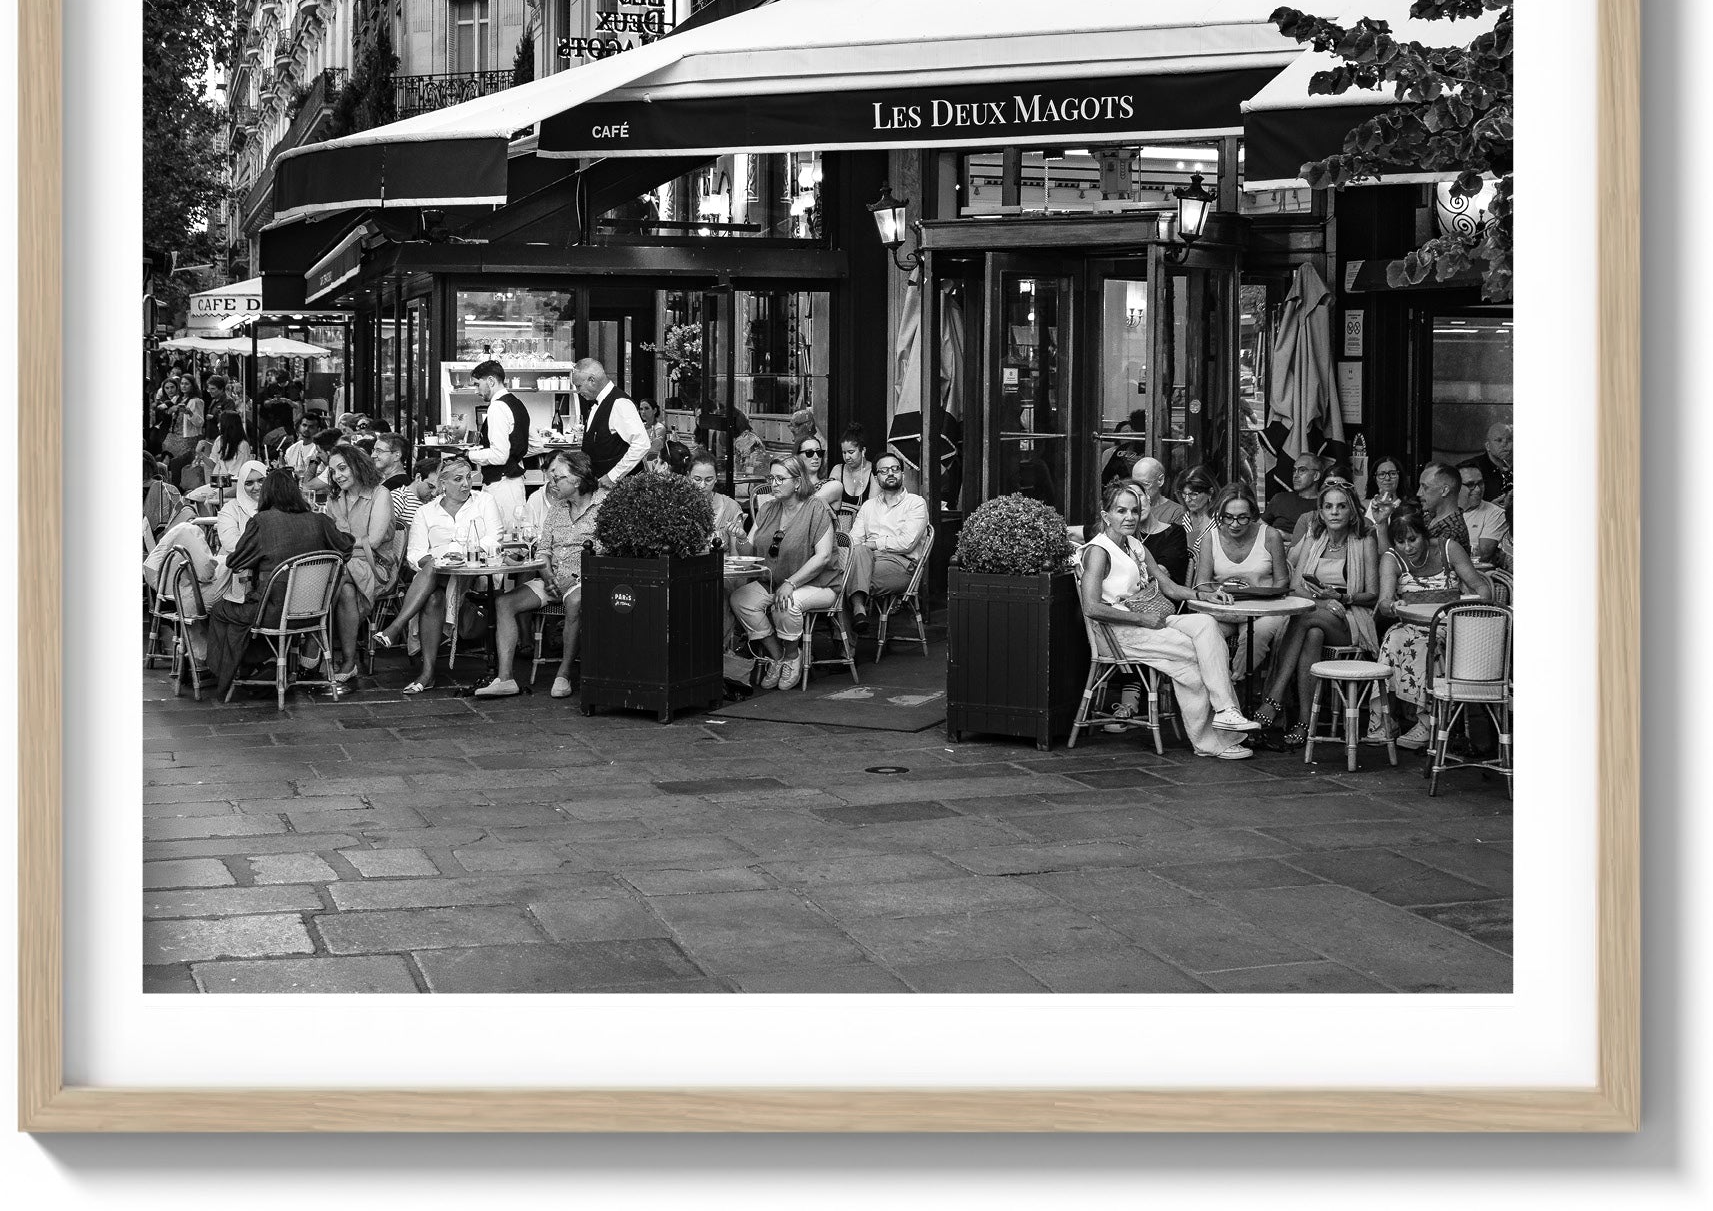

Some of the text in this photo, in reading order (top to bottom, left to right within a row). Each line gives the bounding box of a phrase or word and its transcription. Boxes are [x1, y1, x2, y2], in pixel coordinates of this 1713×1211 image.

[872, 94, 1134, 129] LES DEUX MAGOTS
[591, 121, 630, 138] CAFÉ
[197, 298, 237, 311] CAFE
